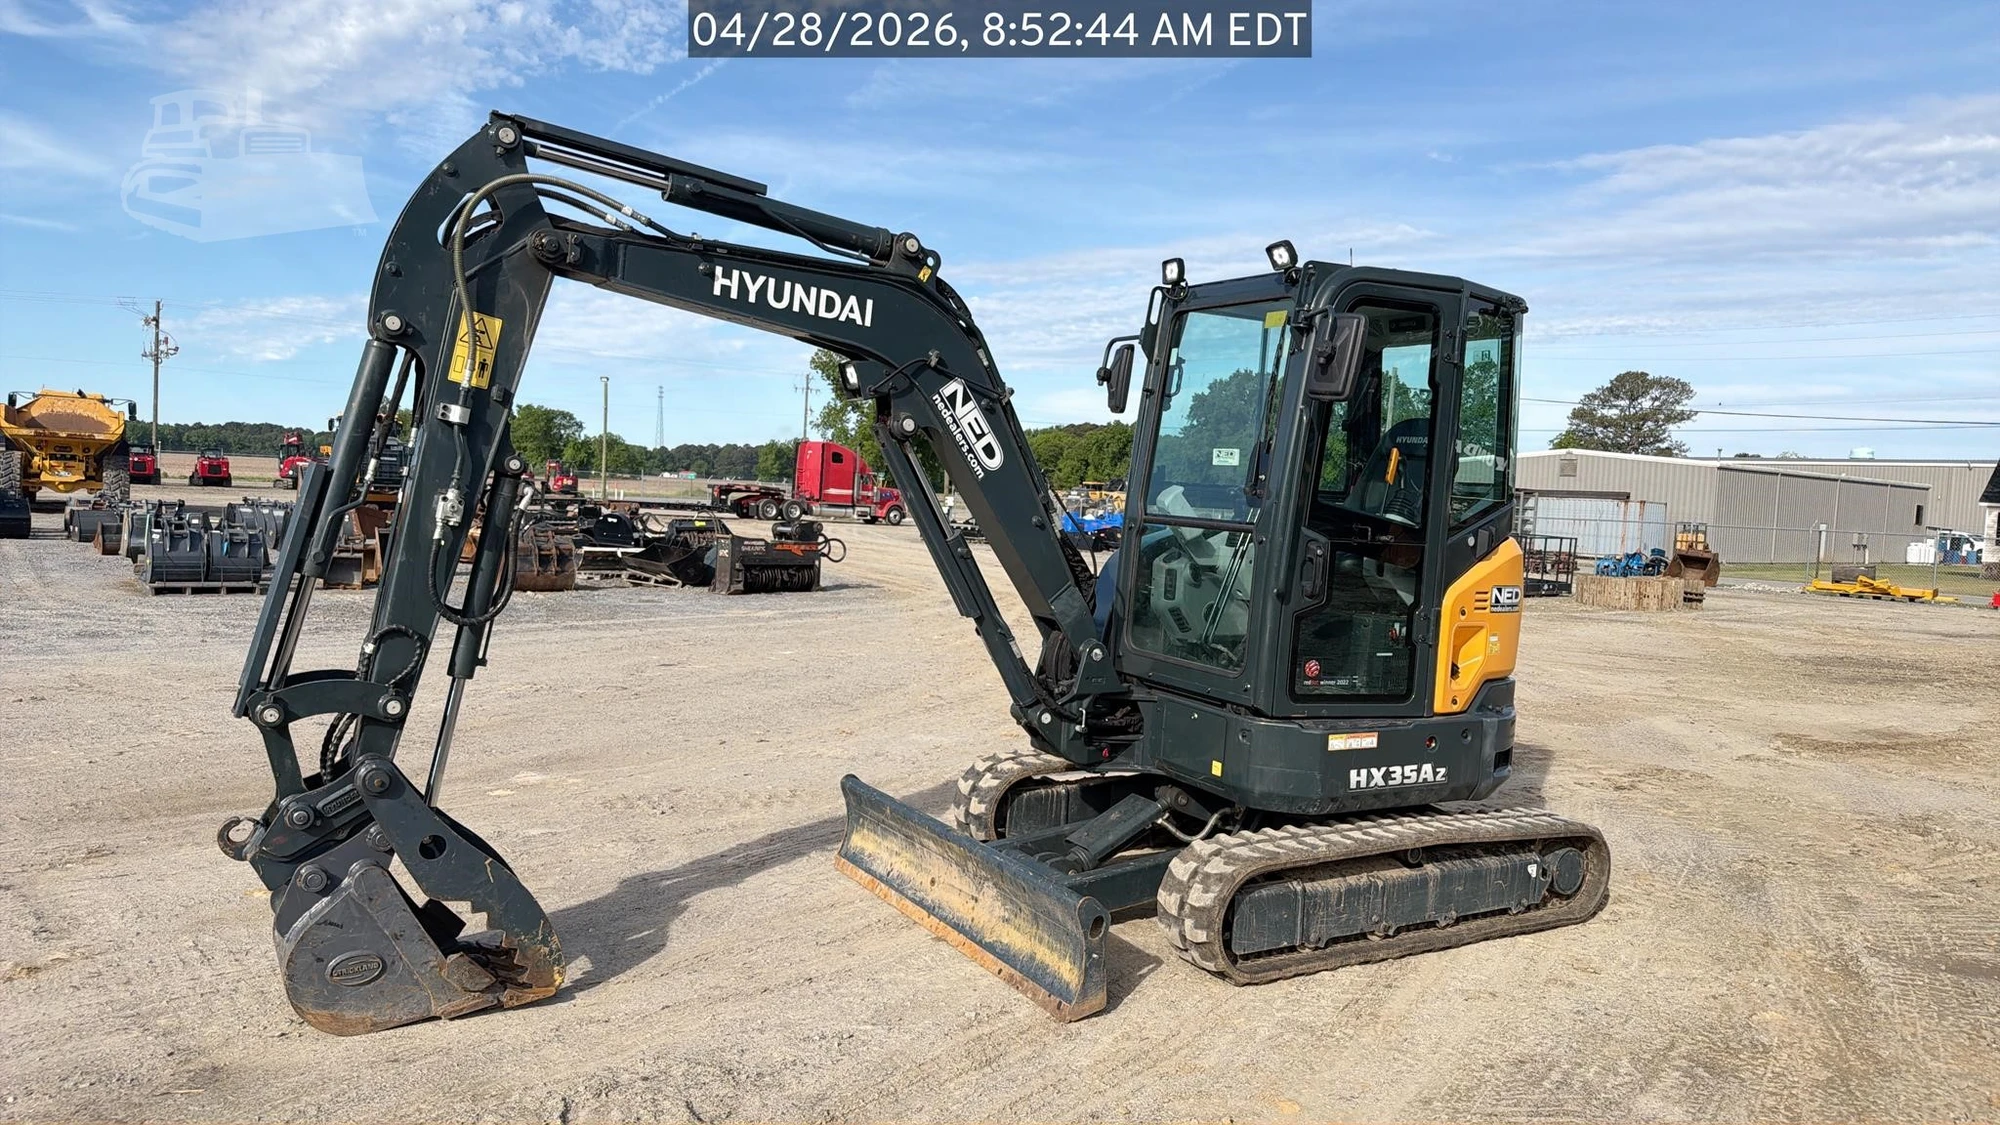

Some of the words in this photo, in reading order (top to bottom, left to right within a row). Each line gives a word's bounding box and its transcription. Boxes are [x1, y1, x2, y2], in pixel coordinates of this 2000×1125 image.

[713, 265, 874, 328] HYUNDAI
[932, 393, 985, 480] nedealers.com
[941, 378, 1002, 469] NED
[1396, 435, 1428, 444] HYUNDA
[1491, 587, 1521, 604] NED
